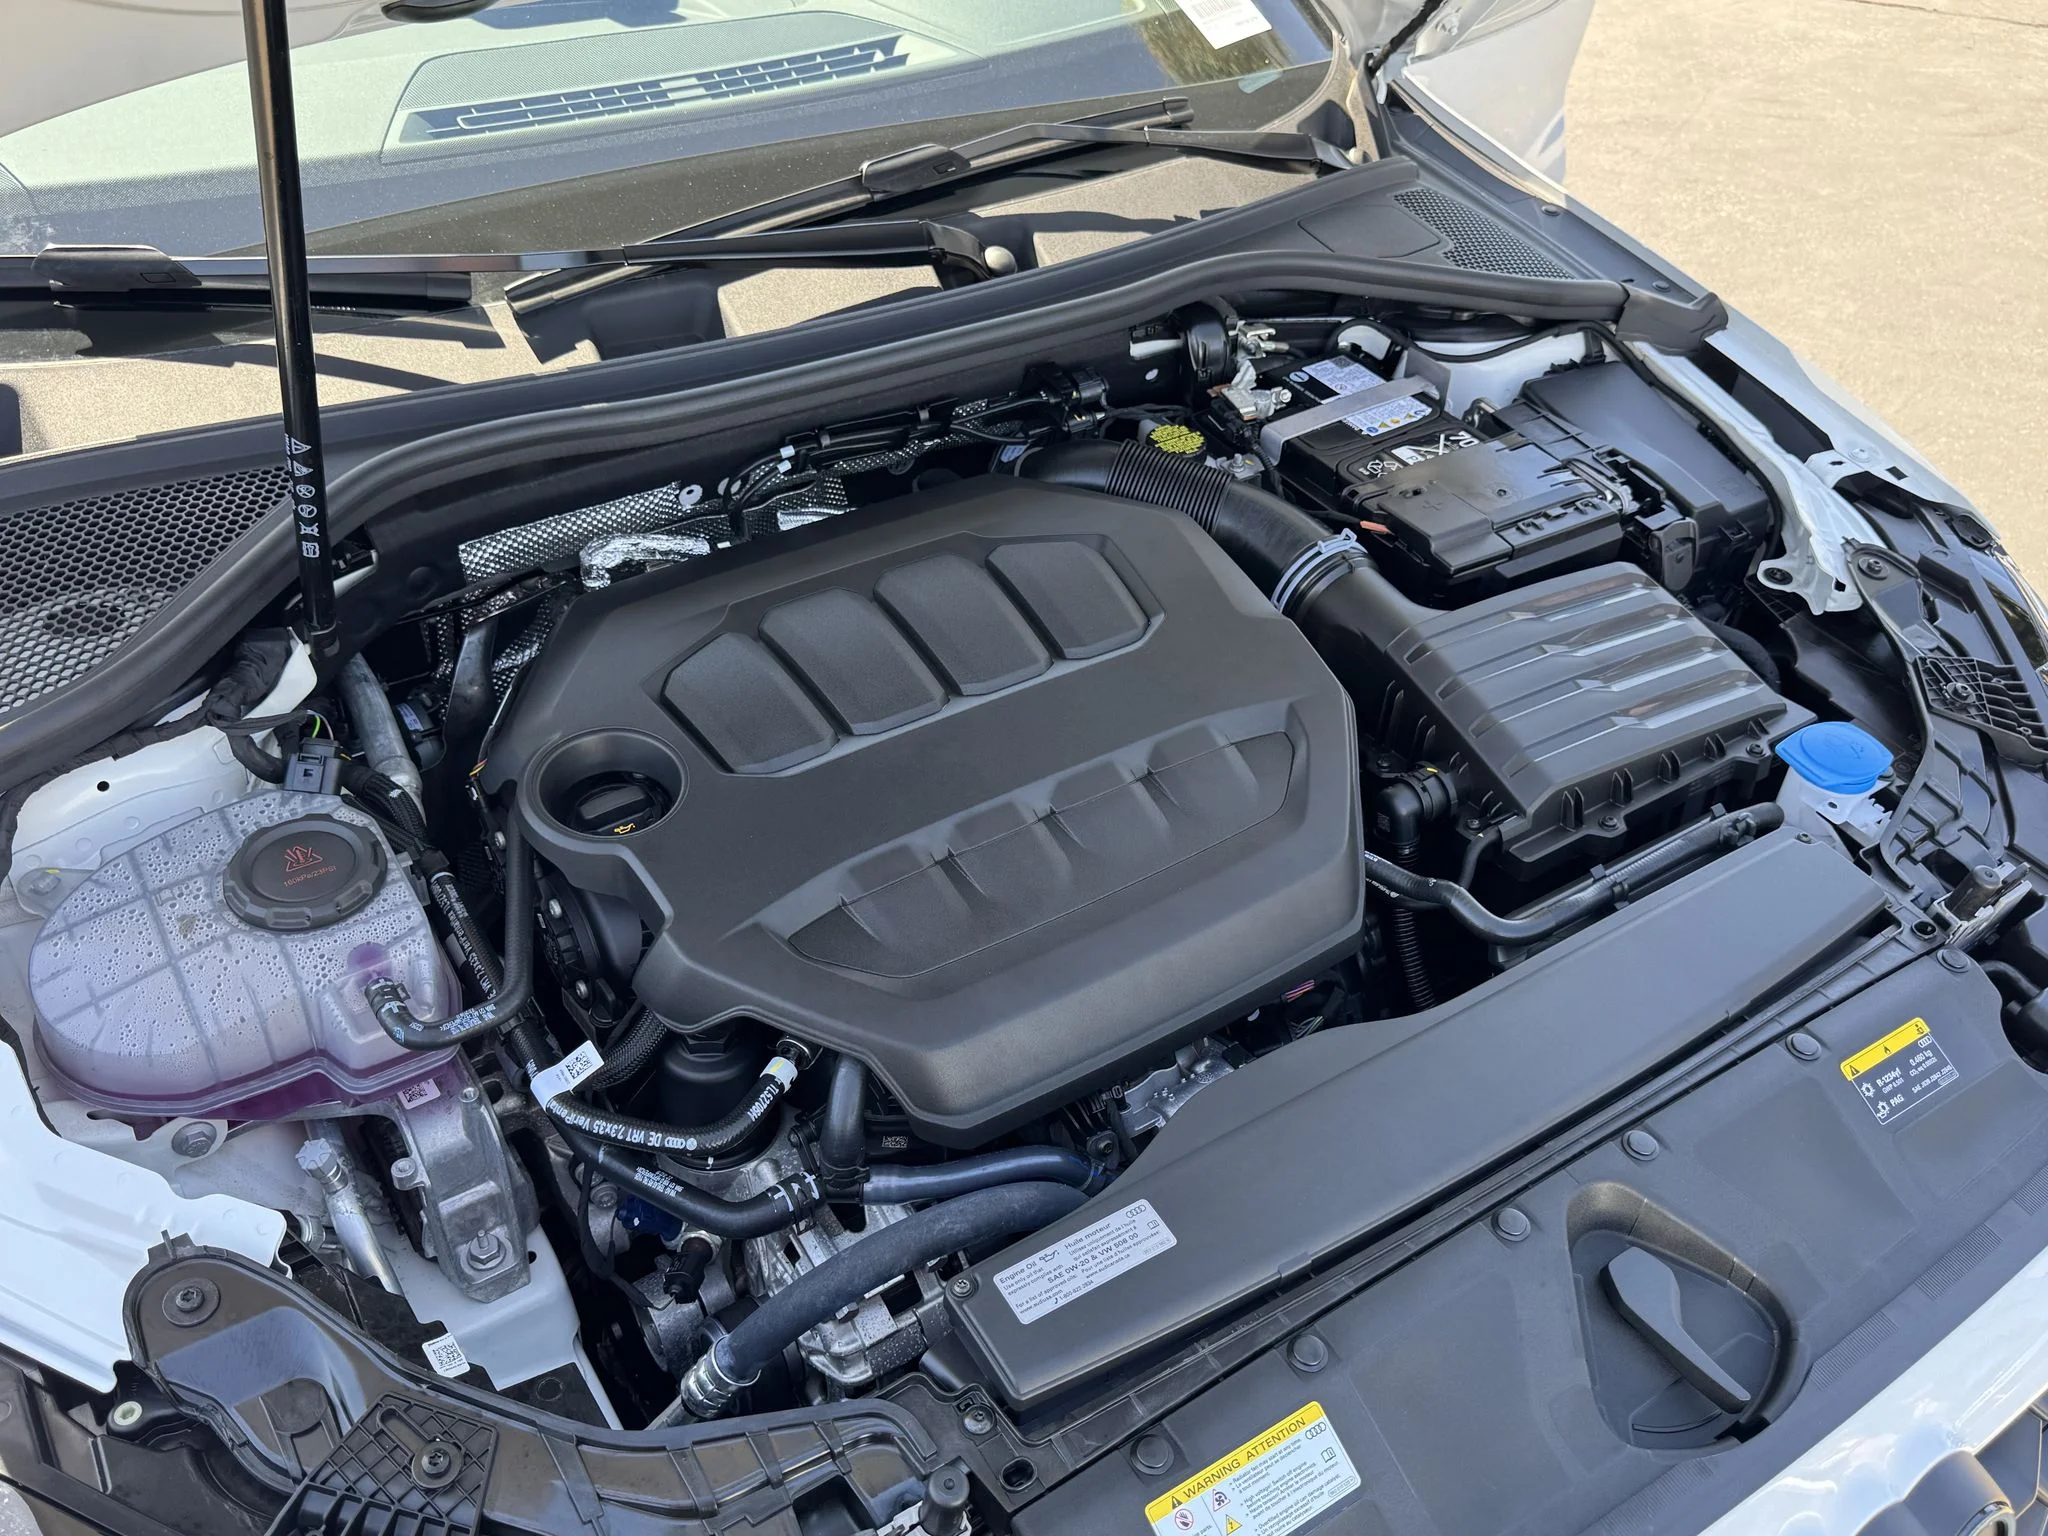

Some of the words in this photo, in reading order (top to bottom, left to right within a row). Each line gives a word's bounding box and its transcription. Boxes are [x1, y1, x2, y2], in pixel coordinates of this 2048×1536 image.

[1449, 431, 1480, 448] 70
[1876, 1067, 1902, 1087] R-1234yf
[747, 1088, 779, 1122] TL52706H
[1890, 1094, 1904, 1107] PAG
[625, 1131, 646, 1145] VRT
[648, 1132, 662, 1147] DE
[1064, 1237, 1084, 1250] Huile
[1084, 1223, 1110, 1239] moteur
[1047, 1271, 1065, 1283] SAE
[1098, 1245, 1112, 1256] VW
[1128, 1232, 1139, 1240] 00
[1081, 1265, 1093, 1273] Pour
[1094, 1260, 1103, 1268] une
[999, 1268, 1025, 1284] Engine
[1026, 1261, 1037, 1270] Oil
[1003, 1283, 1014, 1291] Use
[1033, 1267, 1044, 1275] that
[1030, 1270, 1052, 1284] complies
[1053, 1264, 1064, 1272] with
[1044, 1279, 1067, 1295] approved
[1183, 1458, 1241, 1498] WARNING
[1246, 1417, 1306, 1461] ATTENTION
[1232, 1470, 1251, 1483] Radiator
[1258, 1459, 1268, 1467] may
[1241, 1468, 1264, 1484] ventilateur
[1264, 1462, 1274, 1471] peut
[1243, 1495, 1255, 1504] High
[1293, 1461, 1307, 1472] engine
[1242, 1483, 1252, 1491] tout
[1246, 1498, 1261, 1509] before
[1260, 1486, 1282, 1500] touching
[1279, 1477, 1294, 1488] engine
[1249, 1504, 1263, 1514] Haute
[1299, 1470, 1314, 1482] moteur
[1252, 1509, 1265, 1520] avant
[1270, 1495, 1286, 1508] toucher
[1258, 1513, 1280, 1530] Overfilled
[1279, 1504, 1294, 1516] engine
[1299, 1495, 1307, 1503] can
[1307, 1484, 1324, 1497] damage
[1268, 1511, 1294, 1530] remplissage
[1293, 1499, 1310, 1513] excessif
